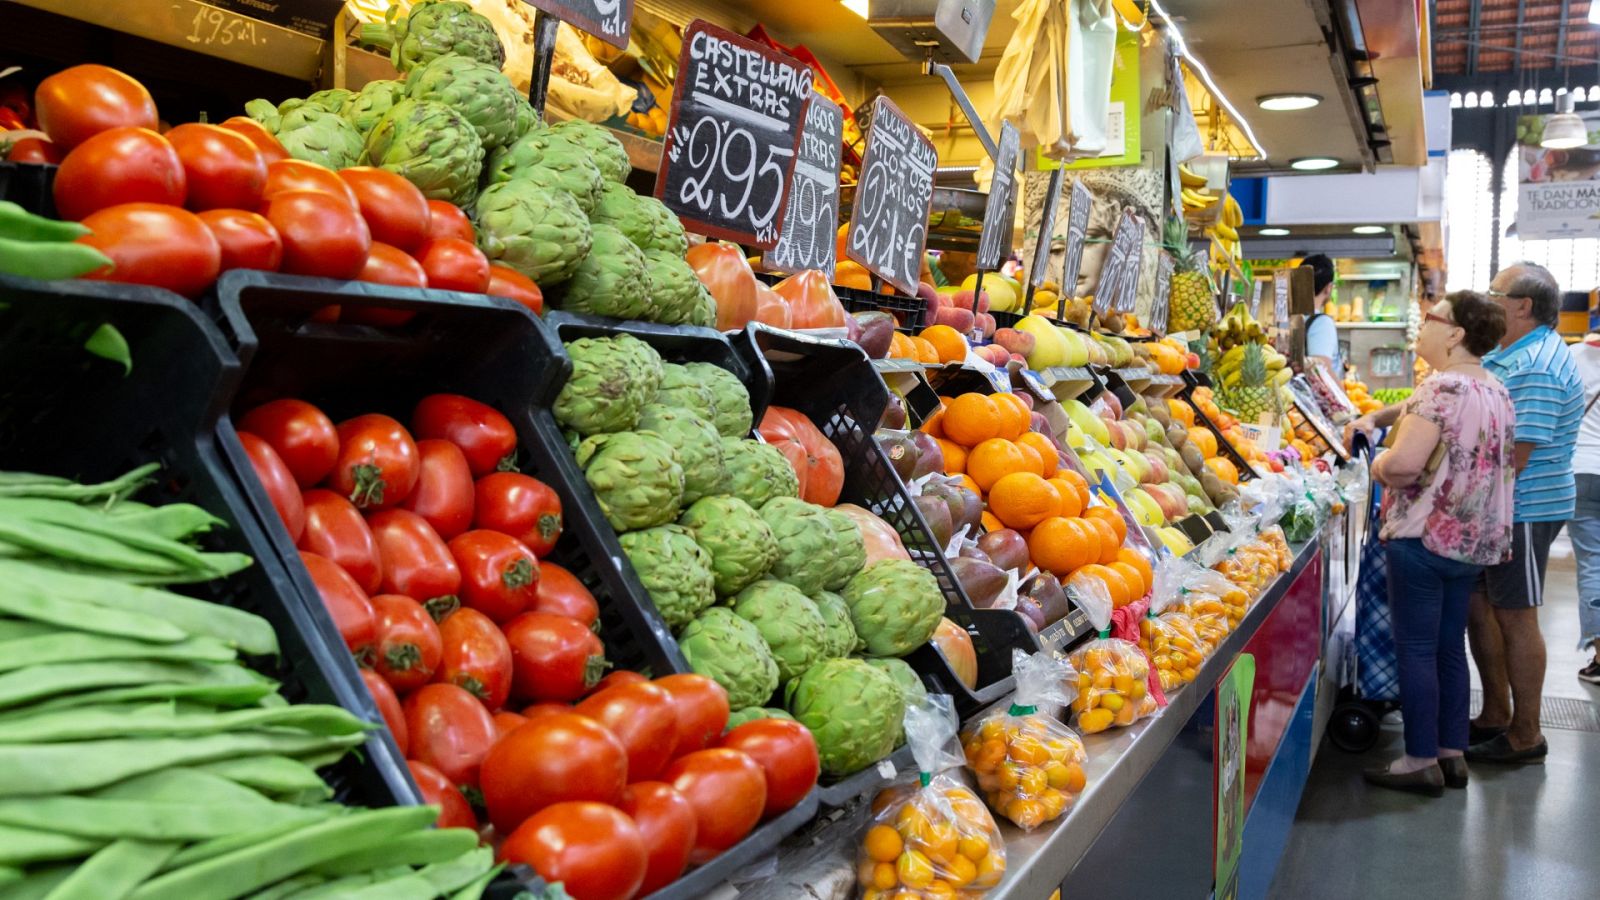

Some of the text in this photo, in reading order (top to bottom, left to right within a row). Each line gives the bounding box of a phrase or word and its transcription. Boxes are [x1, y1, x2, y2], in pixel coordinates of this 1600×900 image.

[695, 62, 790, 118] EXTRAS
[804, 101, 836, 137] NGOS
[877, 101, 909, 145] MUCHO
[802, 131, 836, 168] TRAS
[871, 136, 898, 174] KILO
[1527, 190, 1540, 200] TE
[1544, 188, 1572, 200] DAN
